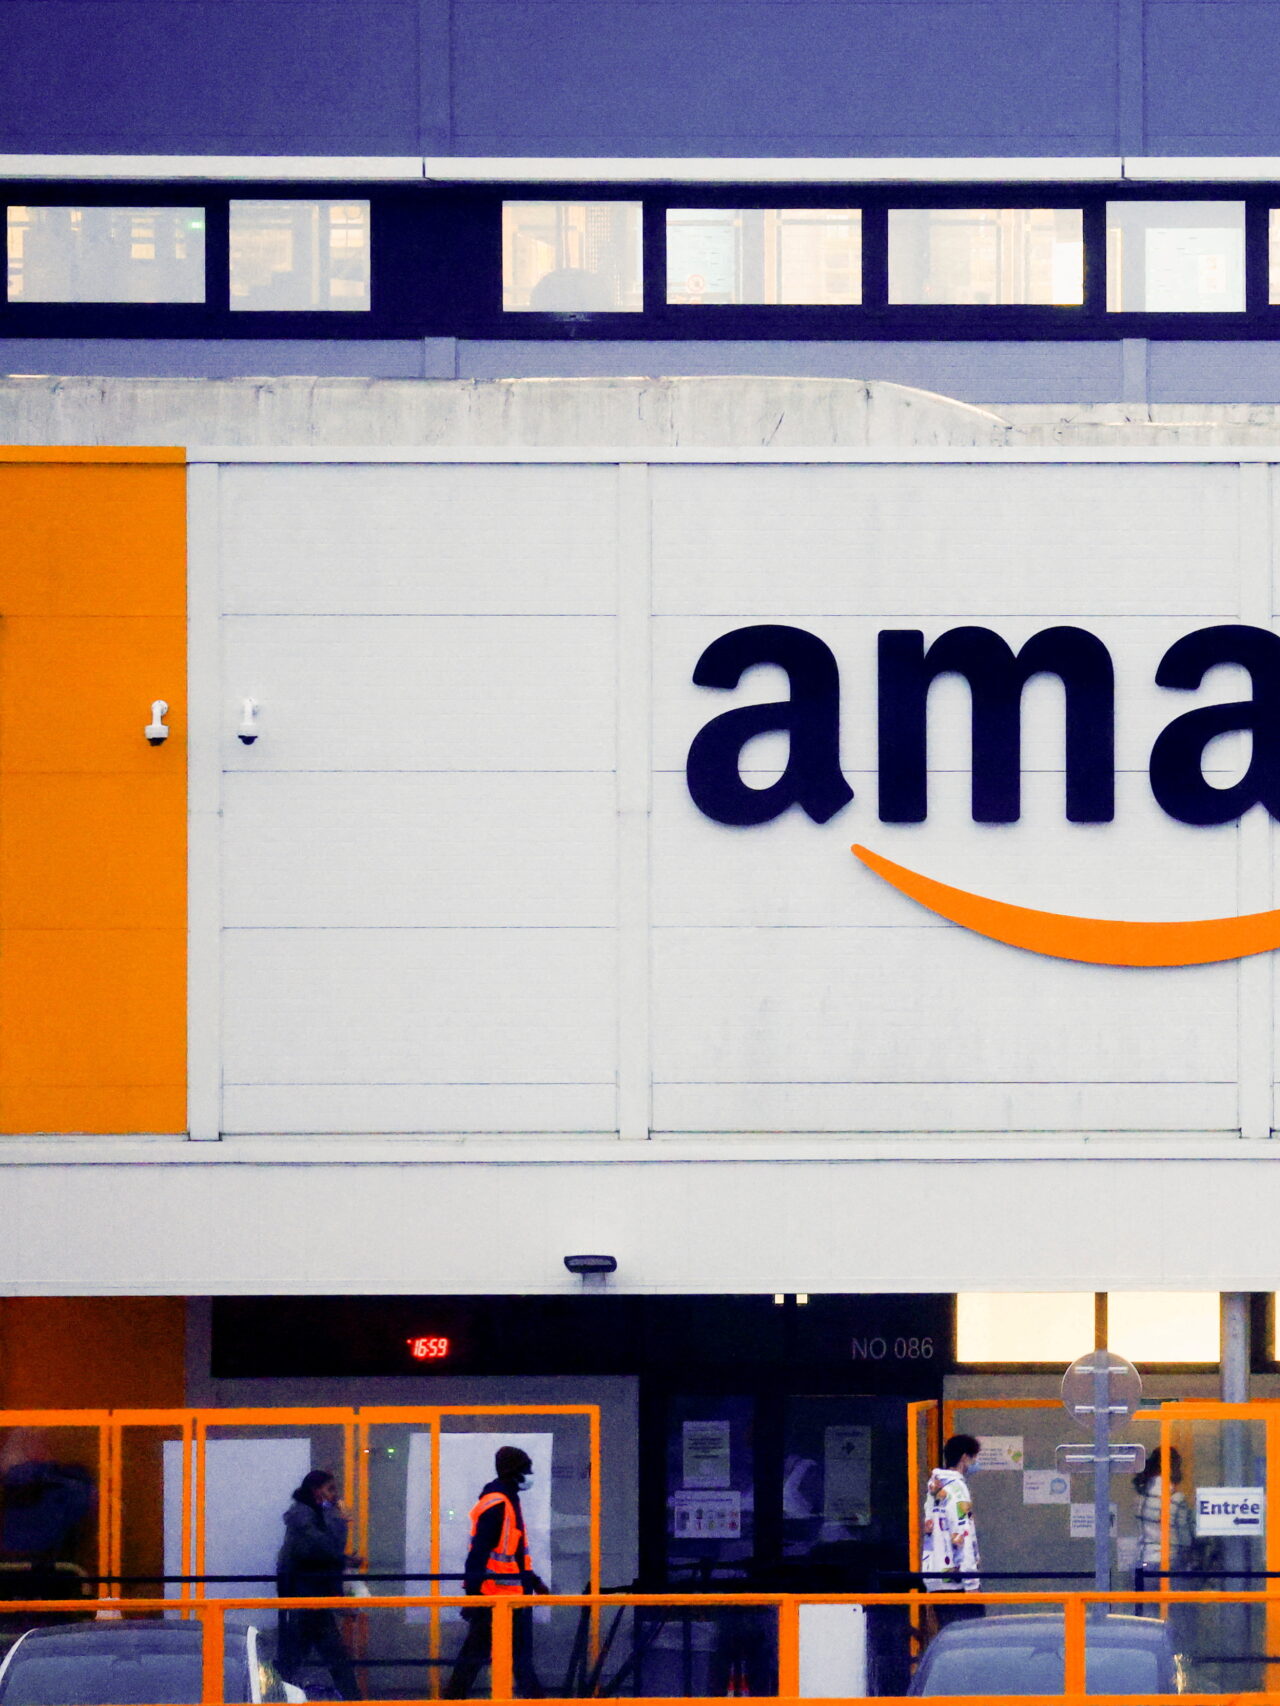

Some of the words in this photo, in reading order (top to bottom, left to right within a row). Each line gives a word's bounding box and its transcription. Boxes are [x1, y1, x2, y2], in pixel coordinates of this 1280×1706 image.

[851, 1337, 887, 1360] NO
[894, 1337, 934, 1359] 086
[1199, 1498, 1261, 1515] Entrée
